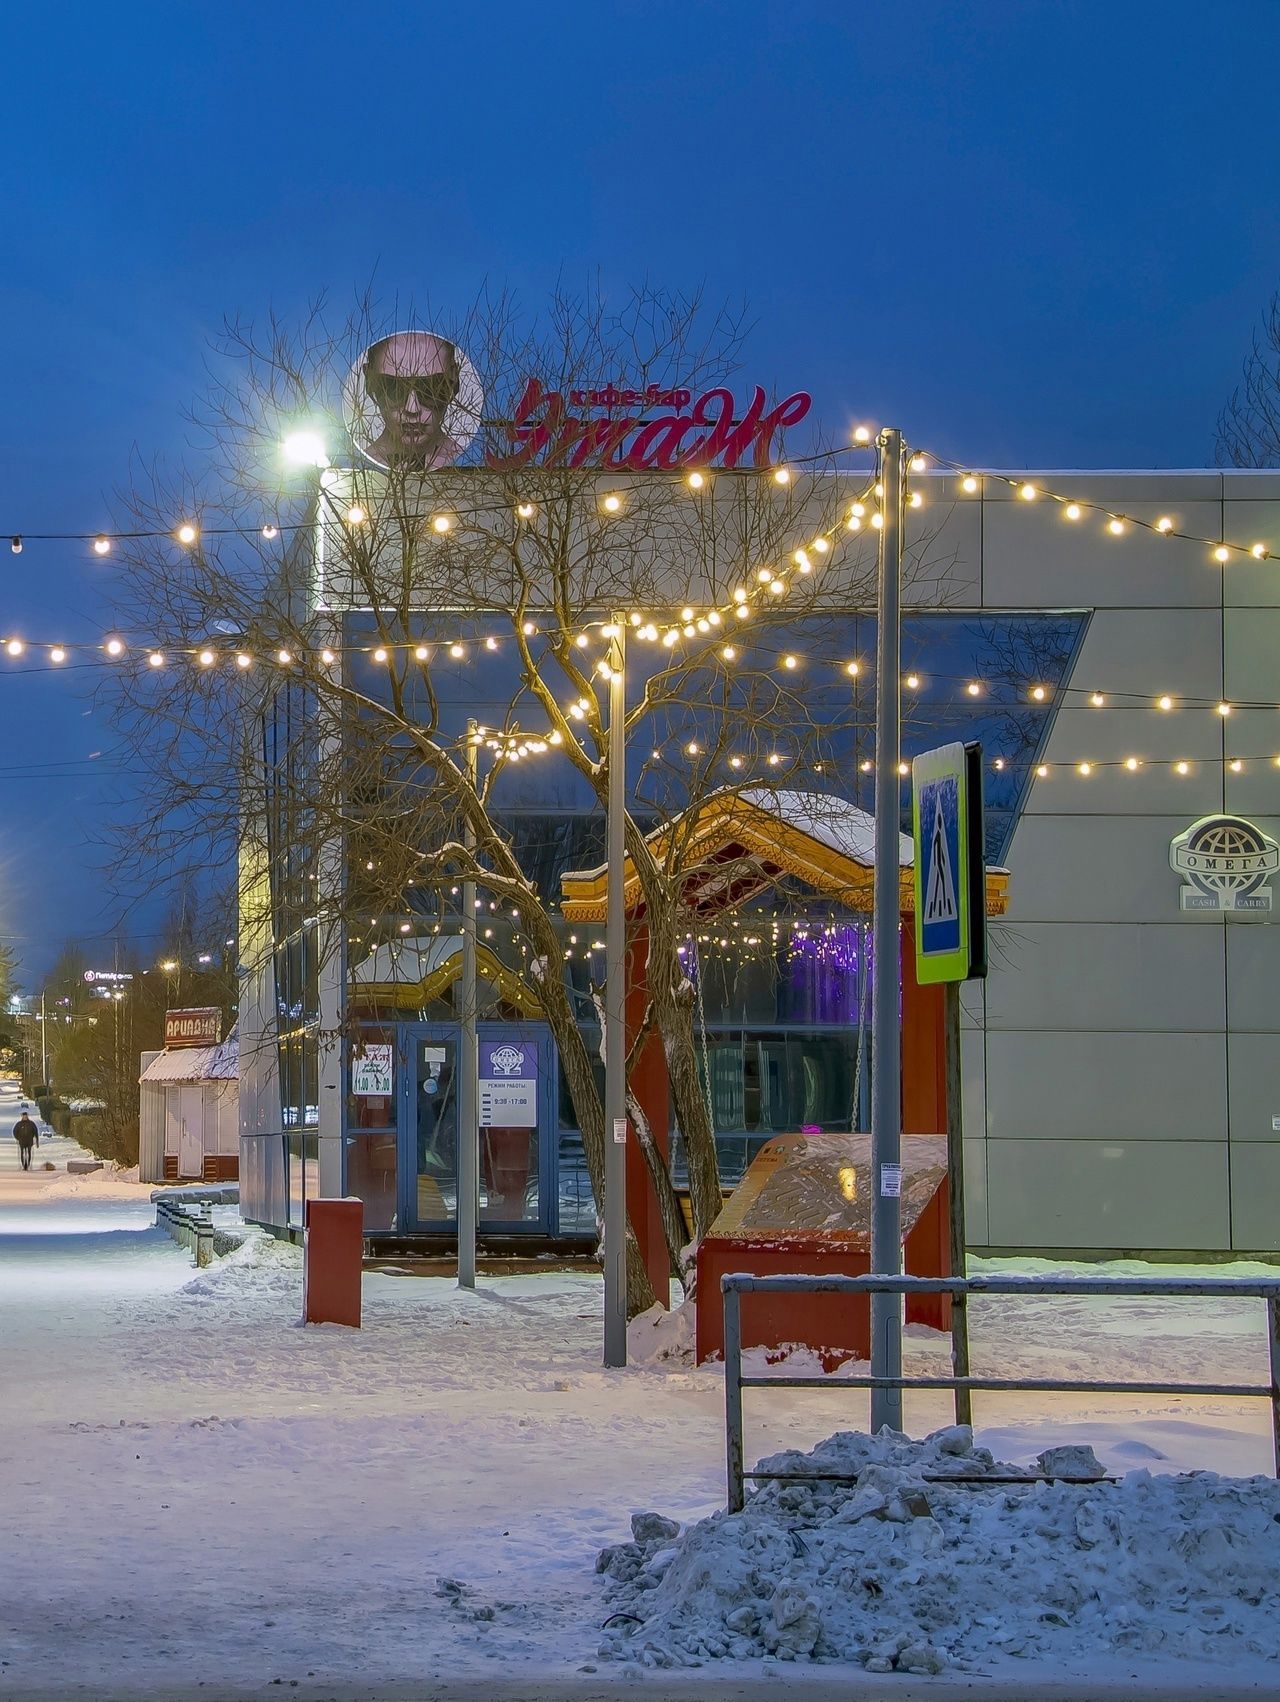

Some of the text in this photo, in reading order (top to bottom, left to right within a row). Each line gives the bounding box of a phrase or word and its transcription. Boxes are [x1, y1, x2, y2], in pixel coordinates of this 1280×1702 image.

[1187, 856, 1267, 870] ОМЕГА
[1192, 899, 1216, 907] CASH
[1237, 899, 1267, 907] CARRY
